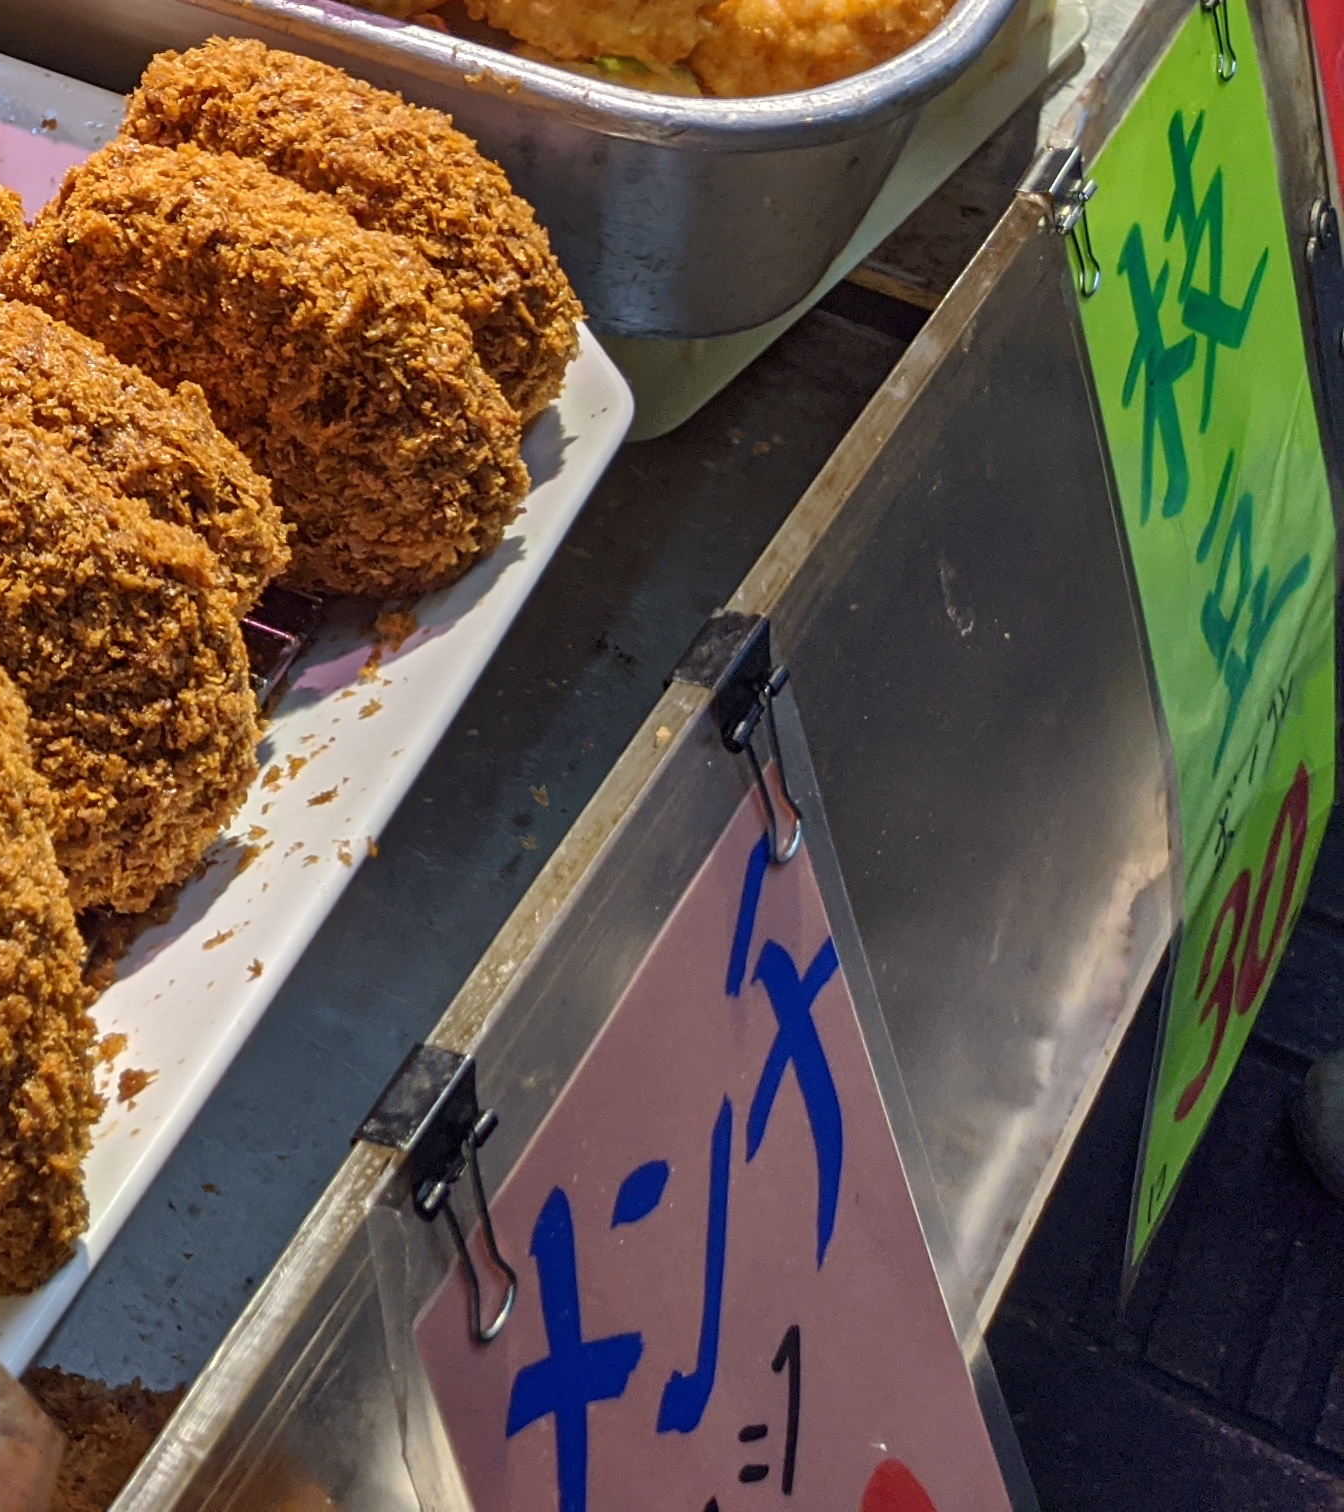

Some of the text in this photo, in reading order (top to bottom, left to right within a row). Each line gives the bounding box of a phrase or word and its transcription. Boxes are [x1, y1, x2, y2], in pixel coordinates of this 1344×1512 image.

[1117, 108, 1311, 778] 枝豆
[504, 831, 840, 1512] メンチ
[1173, 759, 1310, 1123] 30
